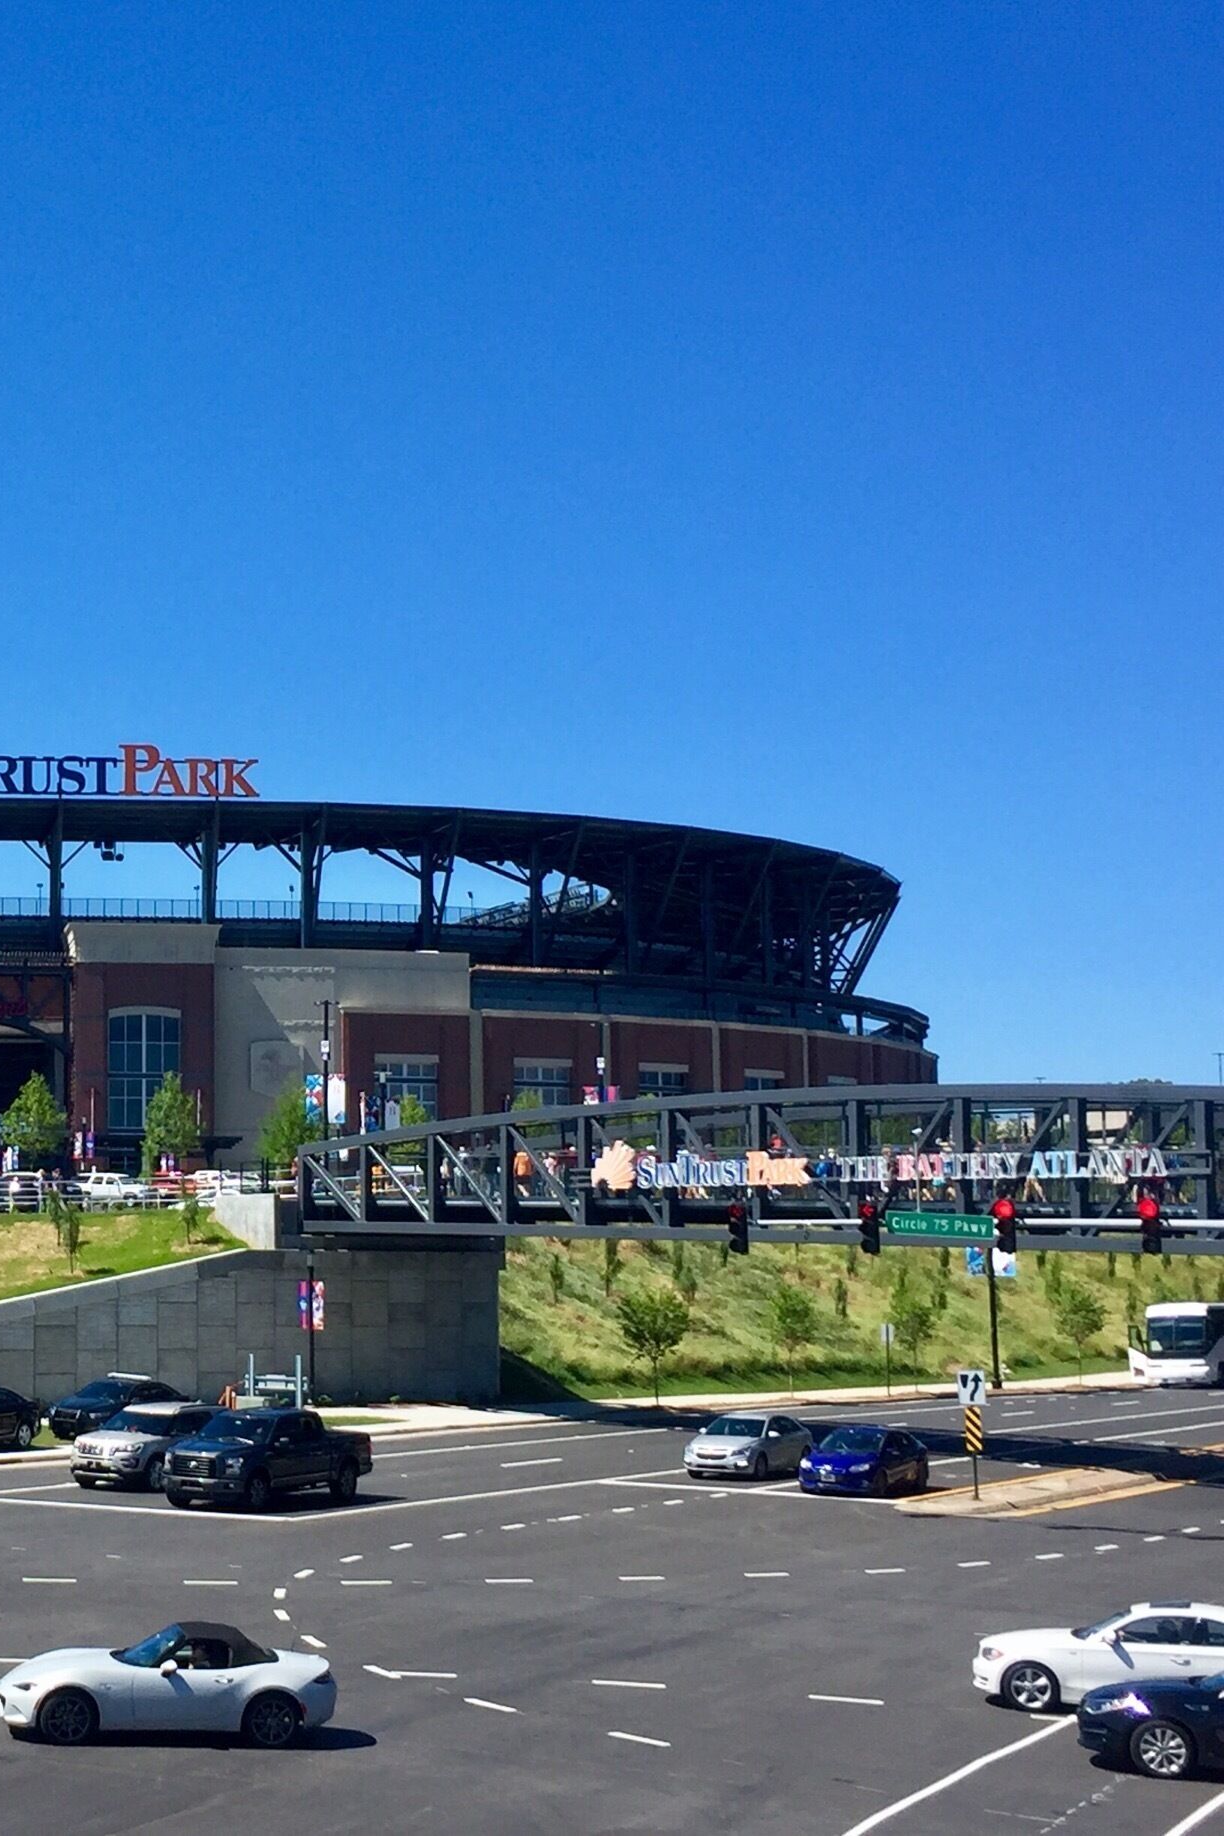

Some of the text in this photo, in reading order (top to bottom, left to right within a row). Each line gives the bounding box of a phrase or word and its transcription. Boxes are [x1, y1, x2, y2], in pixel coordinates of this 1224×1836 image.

[837, 1147, 1169, 1182] THE BATTERY ATLANTA
[891, 1216, 987, 1236] Circle 75 Pkwy
